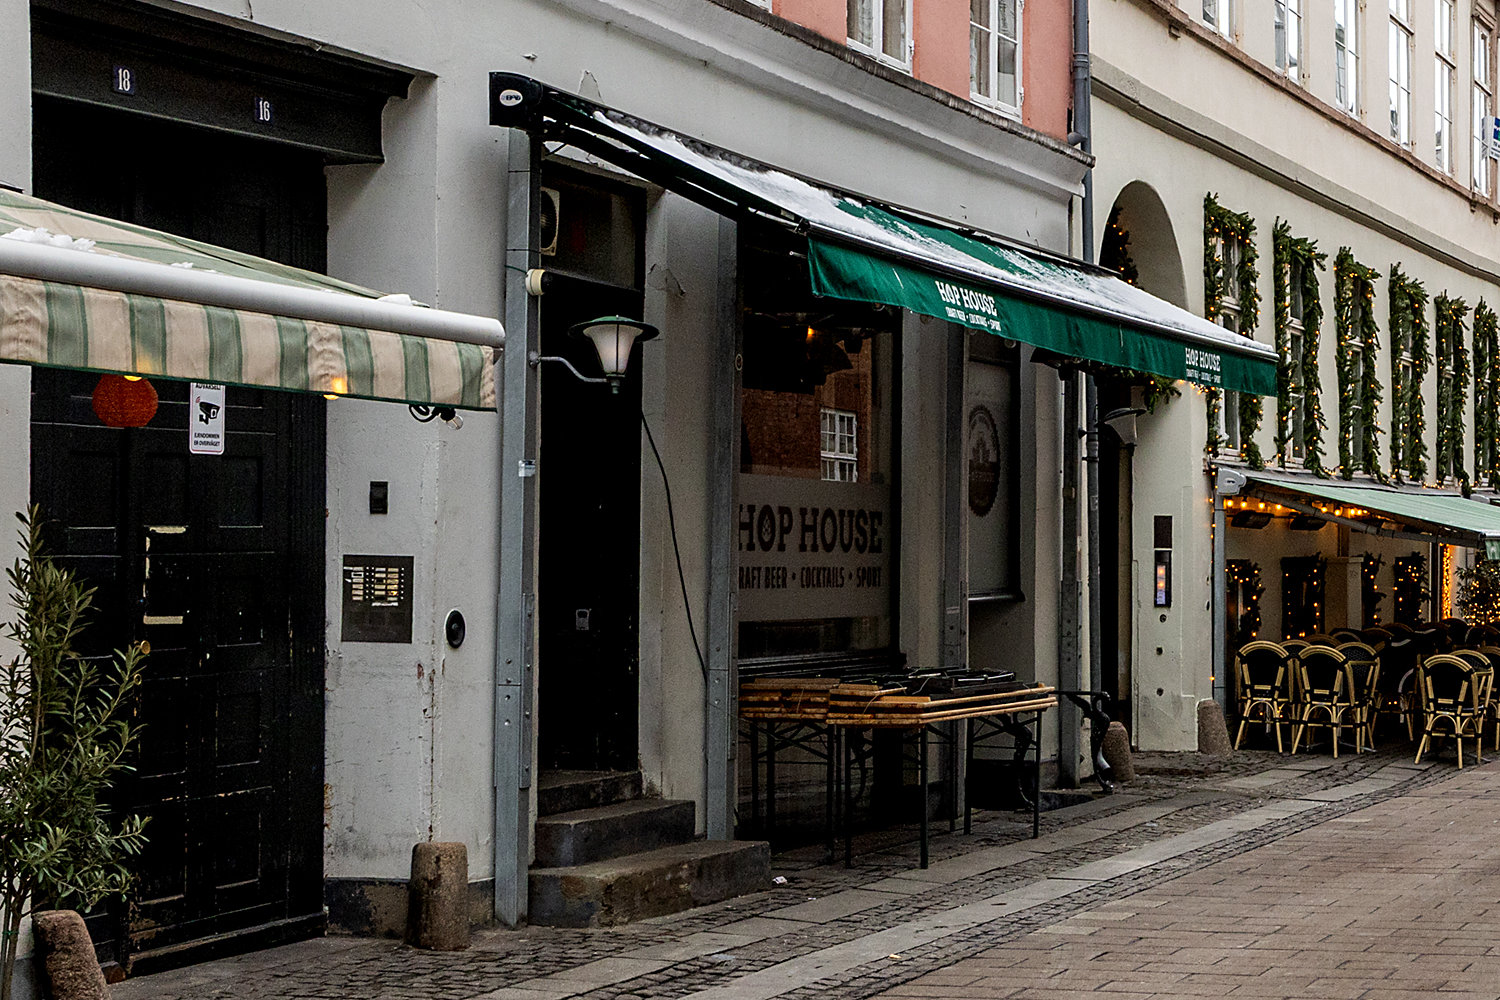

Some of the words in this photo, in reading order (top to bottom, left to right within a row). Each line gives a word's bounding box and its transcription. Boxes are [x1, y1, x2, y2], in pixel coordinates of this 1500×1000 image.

[117, 68, 131, 92] 18
[258, 100, 271, 122] 16
[935, 281, 961, 306] HOP
[959, 287, 998, 317] HOUSE
[1185, 347, 1199, 367] HOP
[1199, 350, 1221, 372] HOUSE
[738, 503, 794, 552] HOP
[798, 506, 883, 554] HOUSE
[738, 566, 762, 589] RAFT
[764, 566, 788, 589] BEER
[800, 566, 845, 589] COCKTAILS
[856, 566, 882, 588] SPORT
